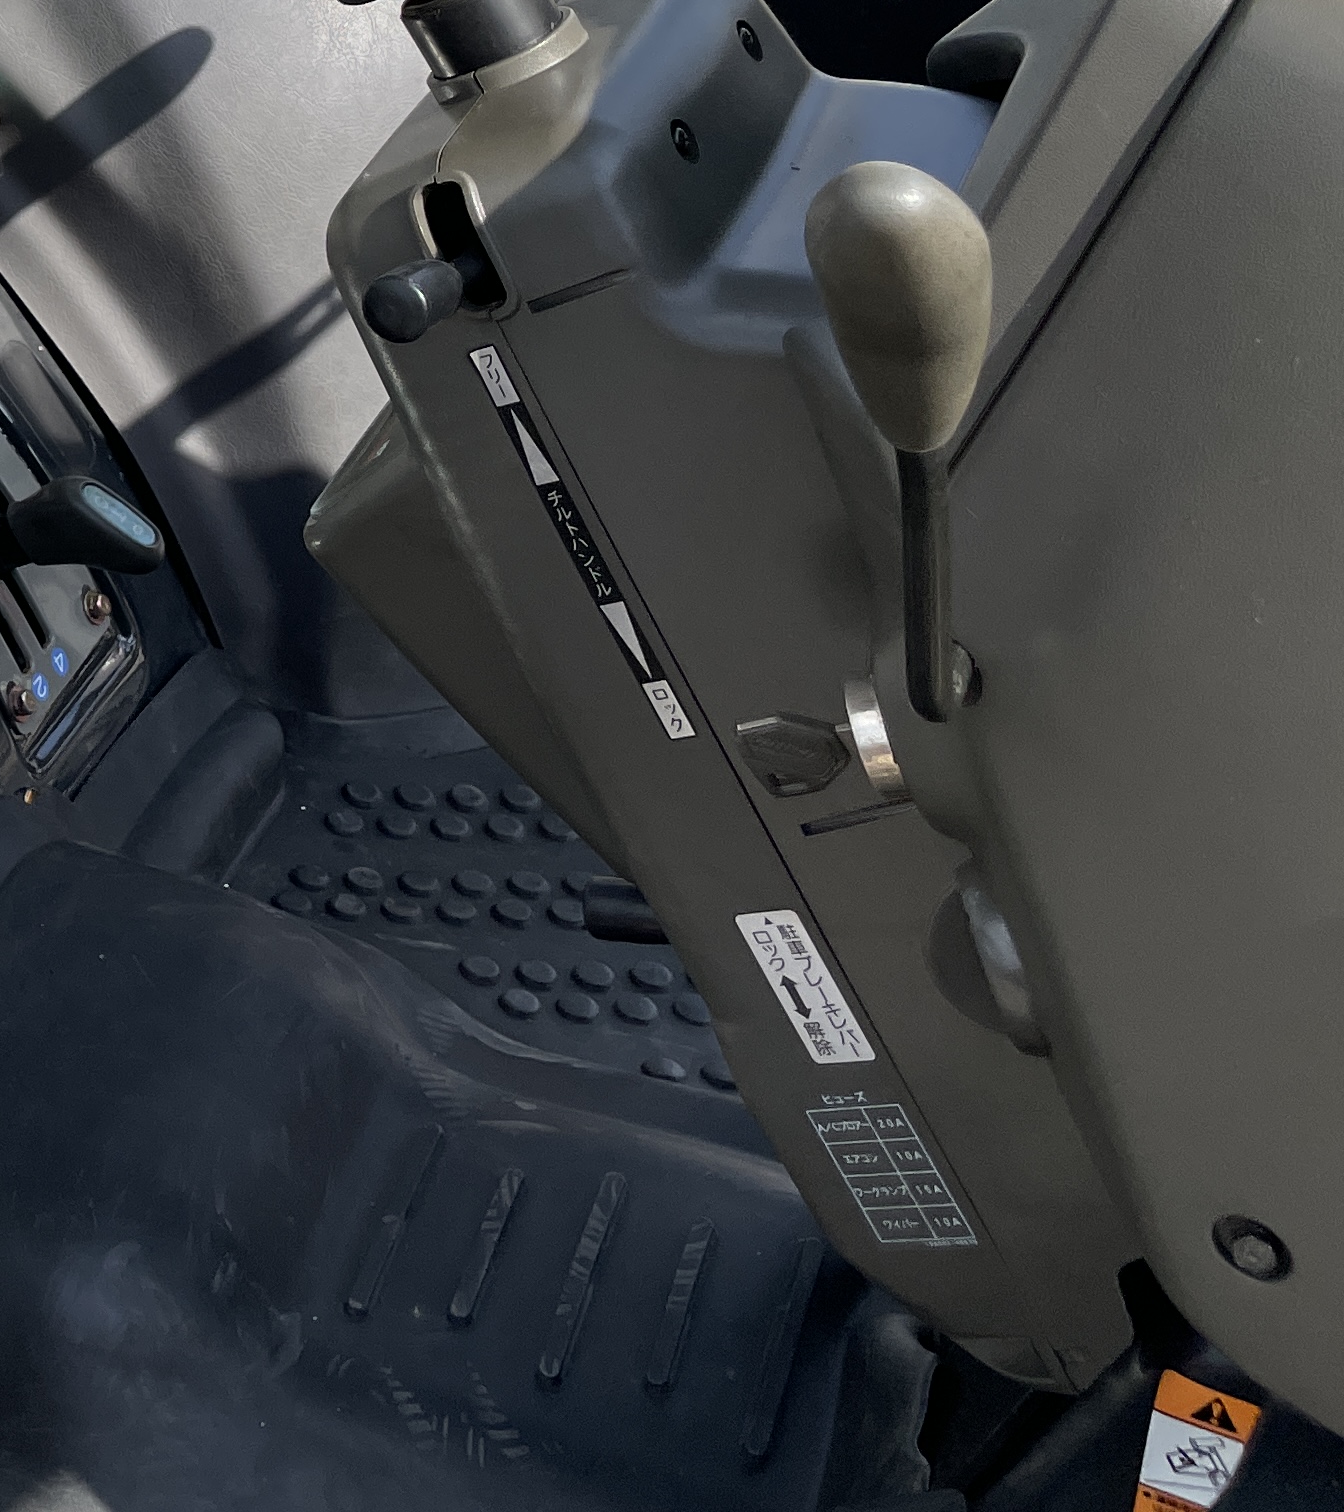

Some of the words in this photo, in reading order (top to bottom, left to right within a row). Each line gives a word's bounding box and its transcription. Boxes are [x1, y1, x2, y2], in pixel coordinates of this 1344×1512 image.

[477, 352, 508, 399] フリー
[546, 490, 612, 598] チルトハンドル
[53, 652, 68, 673] 4
[33, 675, 50, 696] 2
[651, 687, 684, 732] ロック
[752, 930, 785, 972] ロック
[776, 923, 861, 1058] 駐車ブレーキレバー
[803, 1021, 837, 1057] 解除
